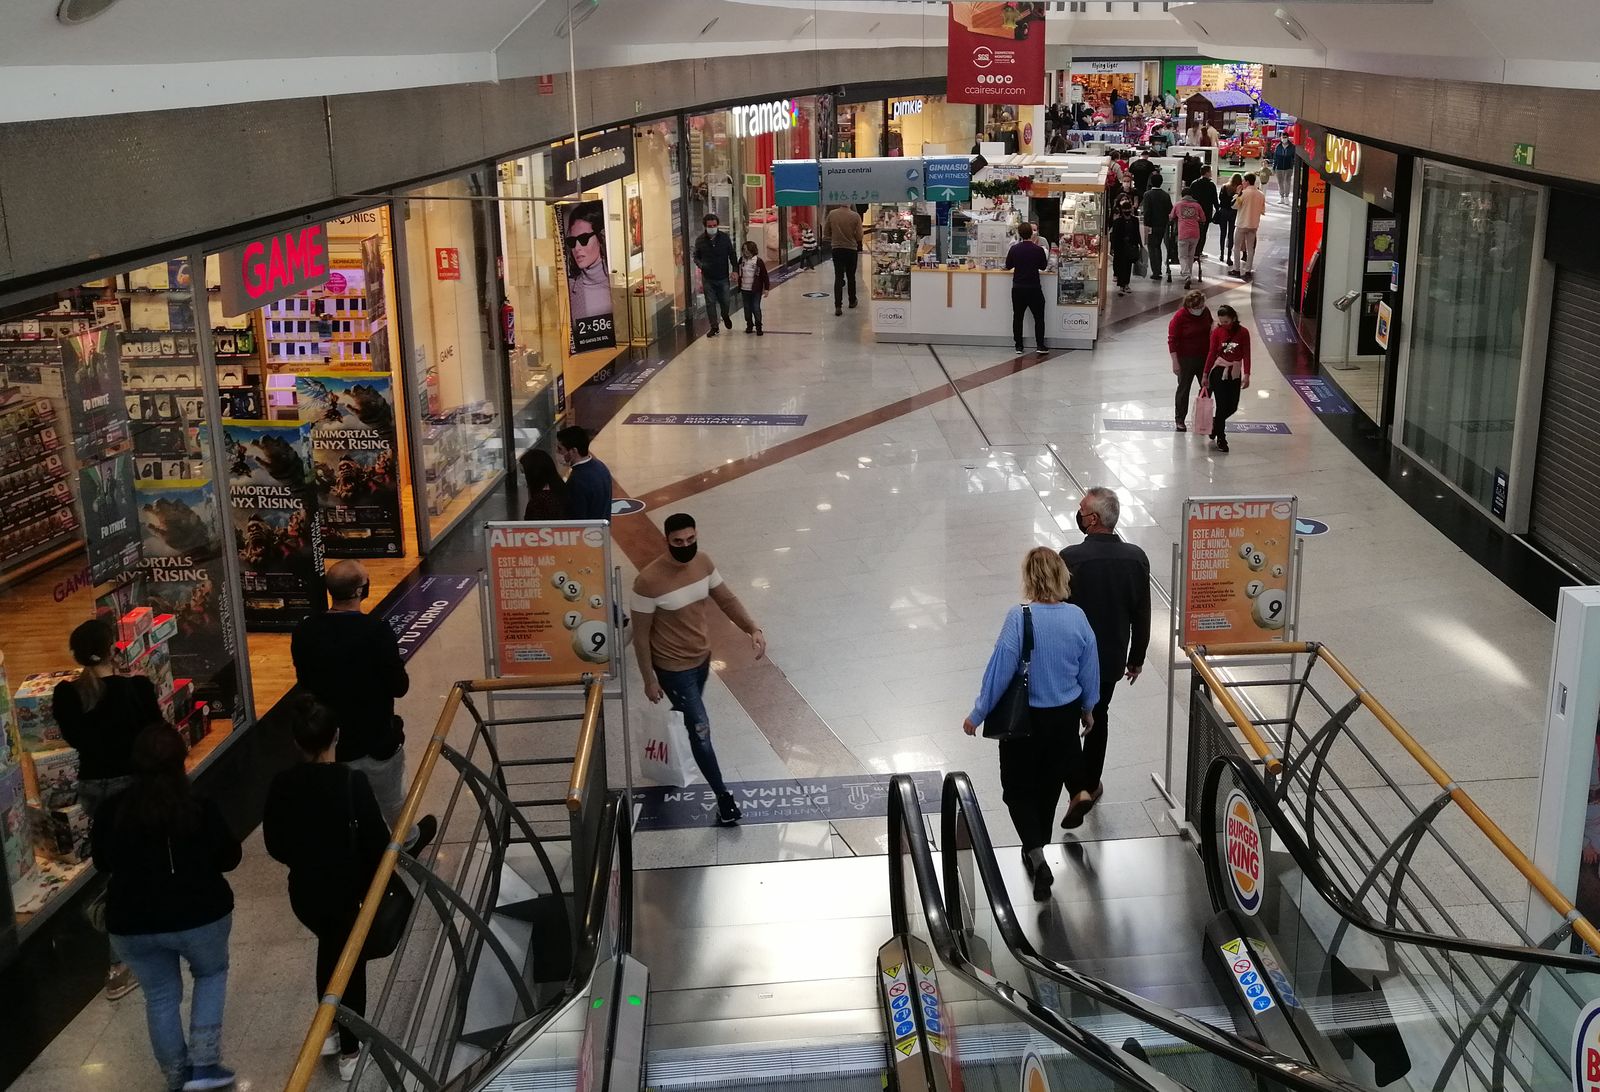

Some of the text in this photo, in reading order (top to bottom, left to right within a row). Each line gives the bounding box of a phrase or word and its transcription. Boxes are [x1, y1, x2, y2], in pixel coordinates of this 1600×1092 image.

[964, 85, 1026, 95] ccairesur.com
[827, 166, 872, 176] plaza central
[929, 163, 969, 172] GIMNASIO
[242, 225, 326, 299] GAME
[315, 429, 379, 439] IMMORTALS
[313, 439, 346, 450] ENYX
[229, 486, 291, 496] MMORTALS
[230, 498, 255, 509] NYX
[1189, 502, 1270, 520] AireSur
[490, 528, 581, 548] AireSur
[1192, 529, 1209, 539] ESTE
[1210, 527, 1227, 539] AÑO,
[1192, 539, 1232, 549] QUE NUNCA,
[1191, 549, 1229, 560] QUEREMOS
[1245, 546, 1252, 556] 9
[136, 556, 193, 568] ORTALS
[497, 557, 516, 567] ESTE
[518, 555, 536, 568] AÑO,
[1191, 559, 1230, 569] REGALARTE
[1253, 554, 1261, 565] 8
[499, 567, 542, 578] QUE NUNCA,
[1276, 567, 1282, 575] 2
[500, 578, 540, 589] QUEREMOS
[558, 576, 565, 585] 9
[500, 588, 543, 599] REGALARTE
[568, 584, 578, 595] 8
[1251, 584, 1259, 594] 7
[595, 598, 602, 606] 2
[1268, 599, 1283, 619] 9
[397, 631, 421, 644] TU
[410, 600, 449, 630] TURNO
[569, 615, 577, 626] 7
[591, 631, 606, 652] 9
[663, 791, 696, 803] 2M
[700, 794, 829, 812] DISTANCA
[738, 809, 770, 818] SIEM
[1228, 817, 1259, 853] BURGER
[1228, 838, 1260, 881] KING
